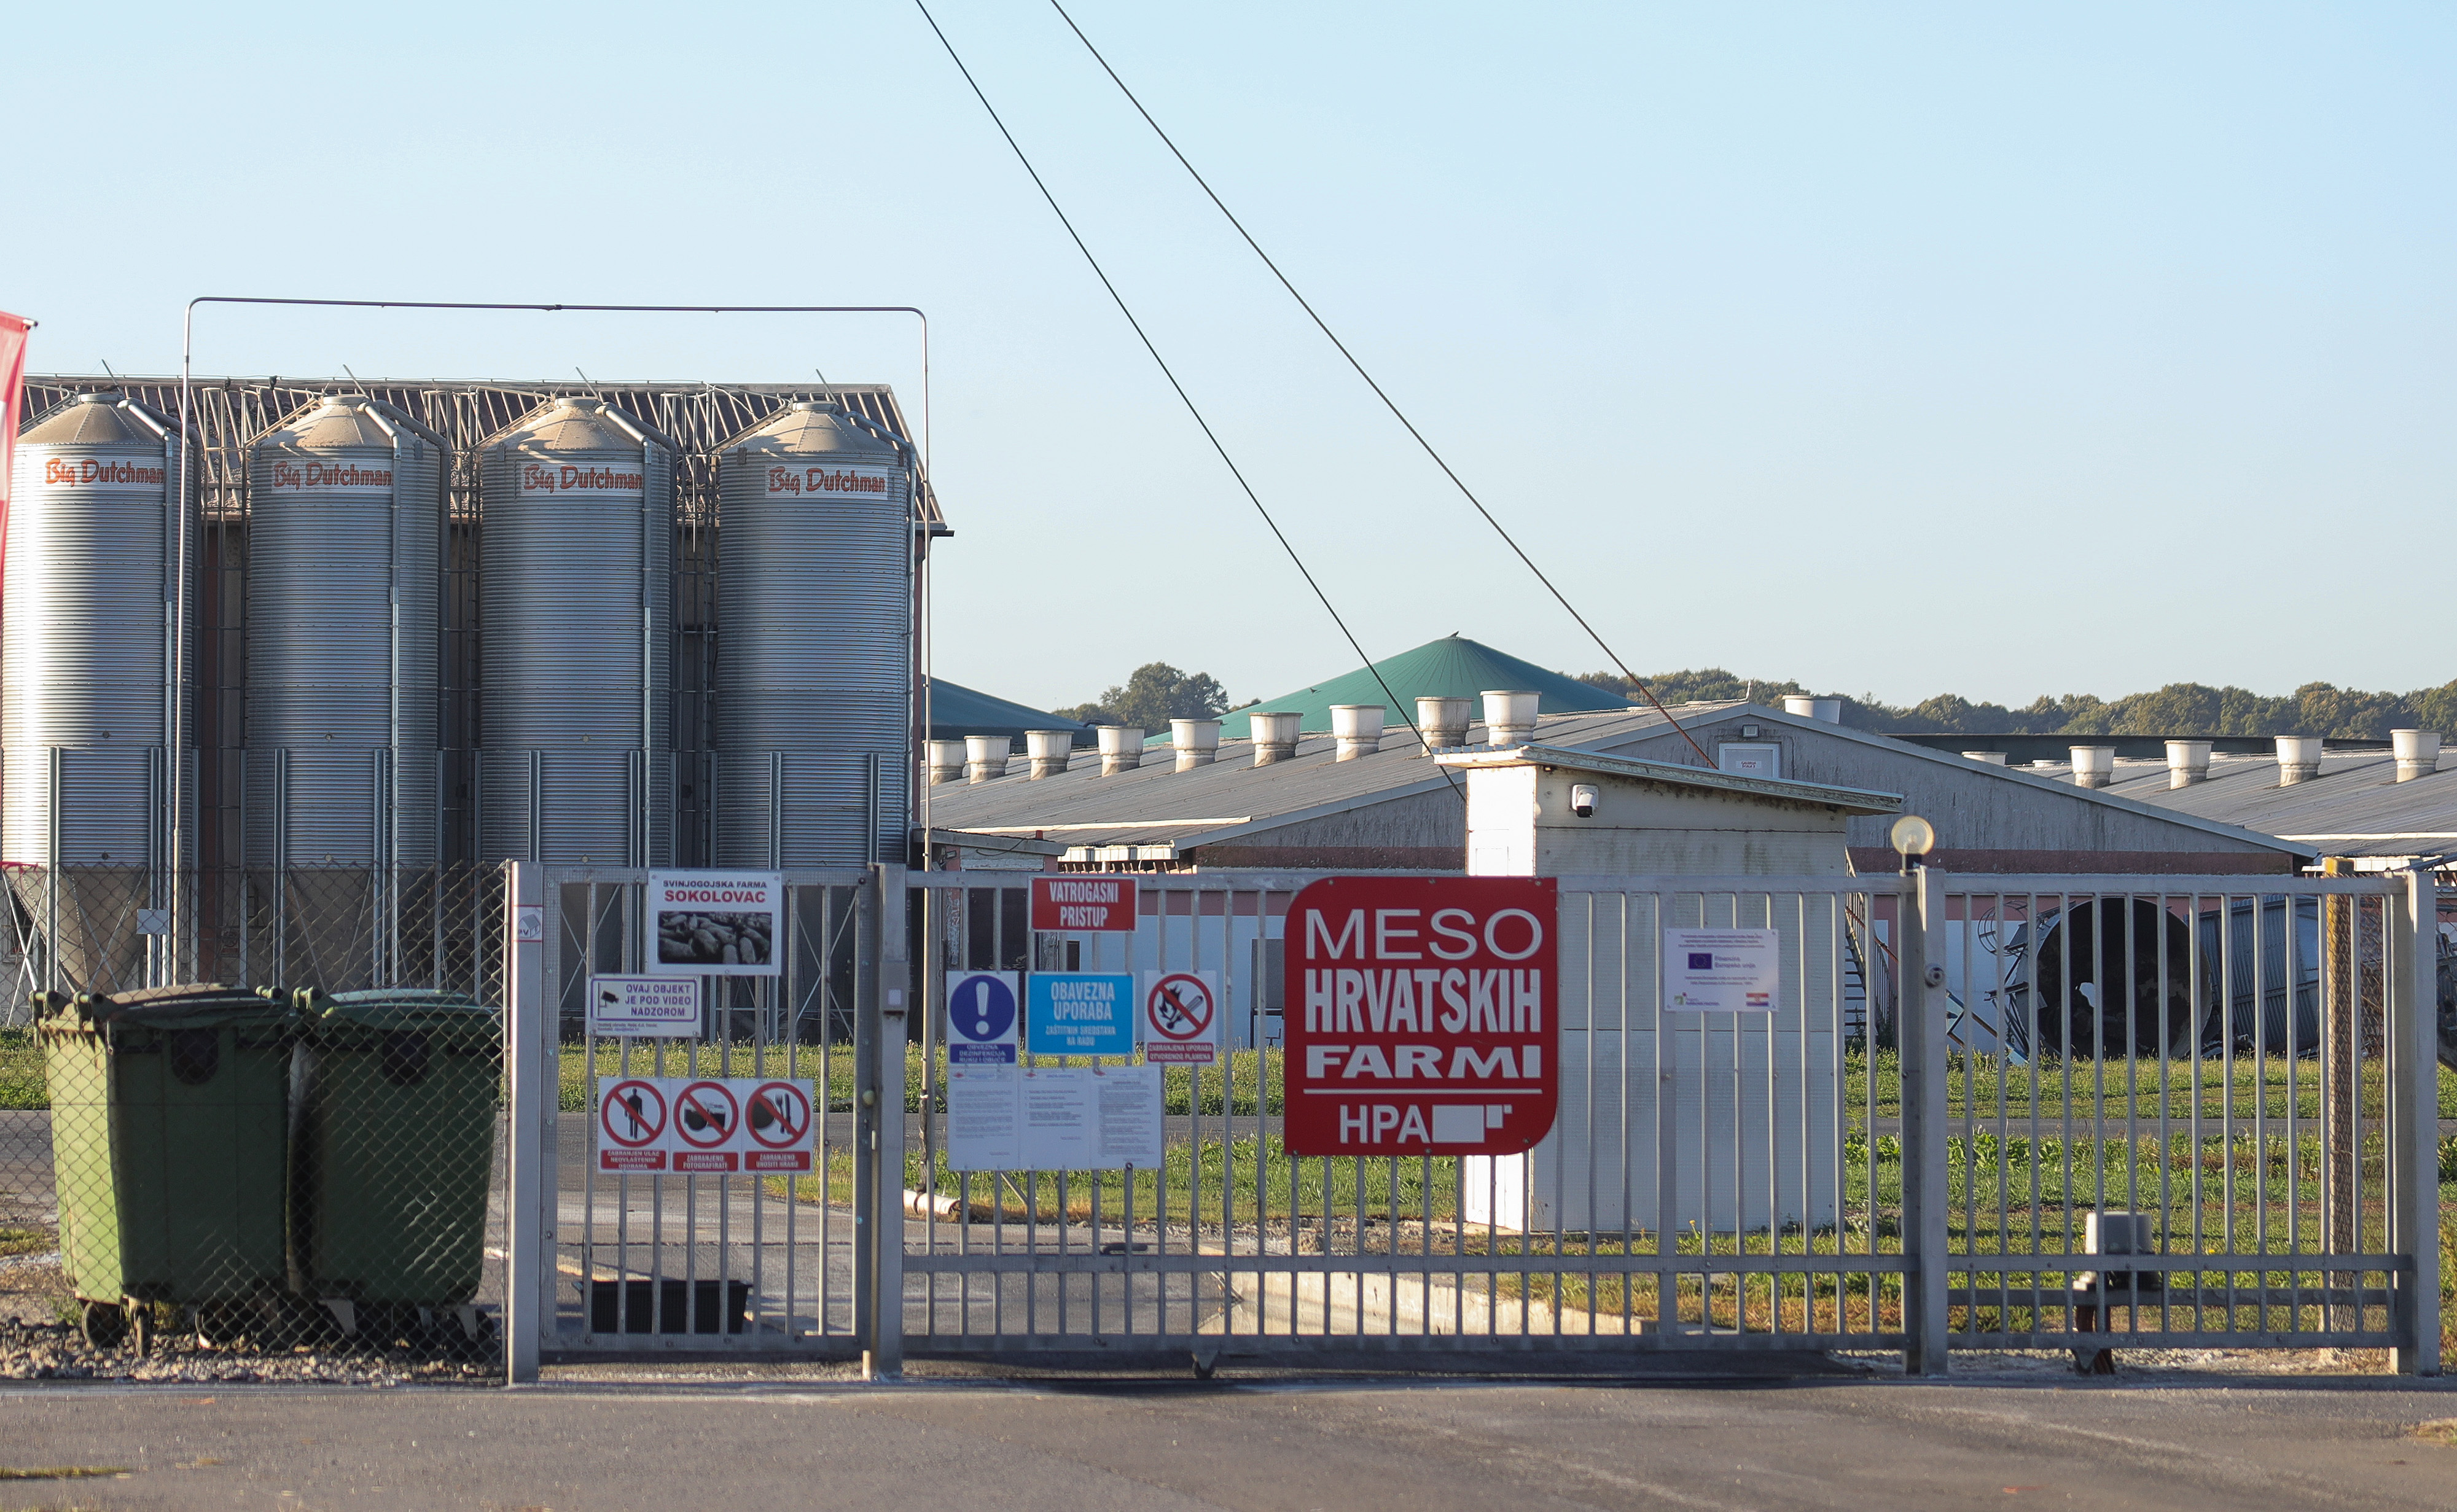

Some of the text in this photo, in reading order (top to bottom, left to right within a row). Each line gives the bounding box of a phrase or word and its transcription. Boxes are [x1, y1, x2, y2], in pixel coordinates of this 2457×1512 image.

[45, 458, 165, 487] Big Dutchman
[273, 461, 392, 490] Big Dutchman
[523, 464, 643, 493] Big Dutchman
[768, 467, 886, 495] Big Dutchman
[664, 890, 766, 903] SOKOLOVAC
[1049, 881, 1119, 903] VATROGASNI
[1060, 906, 1108, 927] PRISTUP
[1305, 908, 1543, 961] MESO
[625, 996, 691, 1005] JE POD VIDEO
[626, 984, 690, 994] OVAJ OBJEKT
[1051, 981, 1115, 1001] OBAVEZNA
[1305, 967, 1541, 1034] HRVATSKIH
[631, 1007, 685, 1016] NADZOROM
[1053, 1002, 1113, 1021] UPORABA
[1307, 1045, 1541, 1078] FARMI
[1340, 1105, 1431, 1144] HPA
